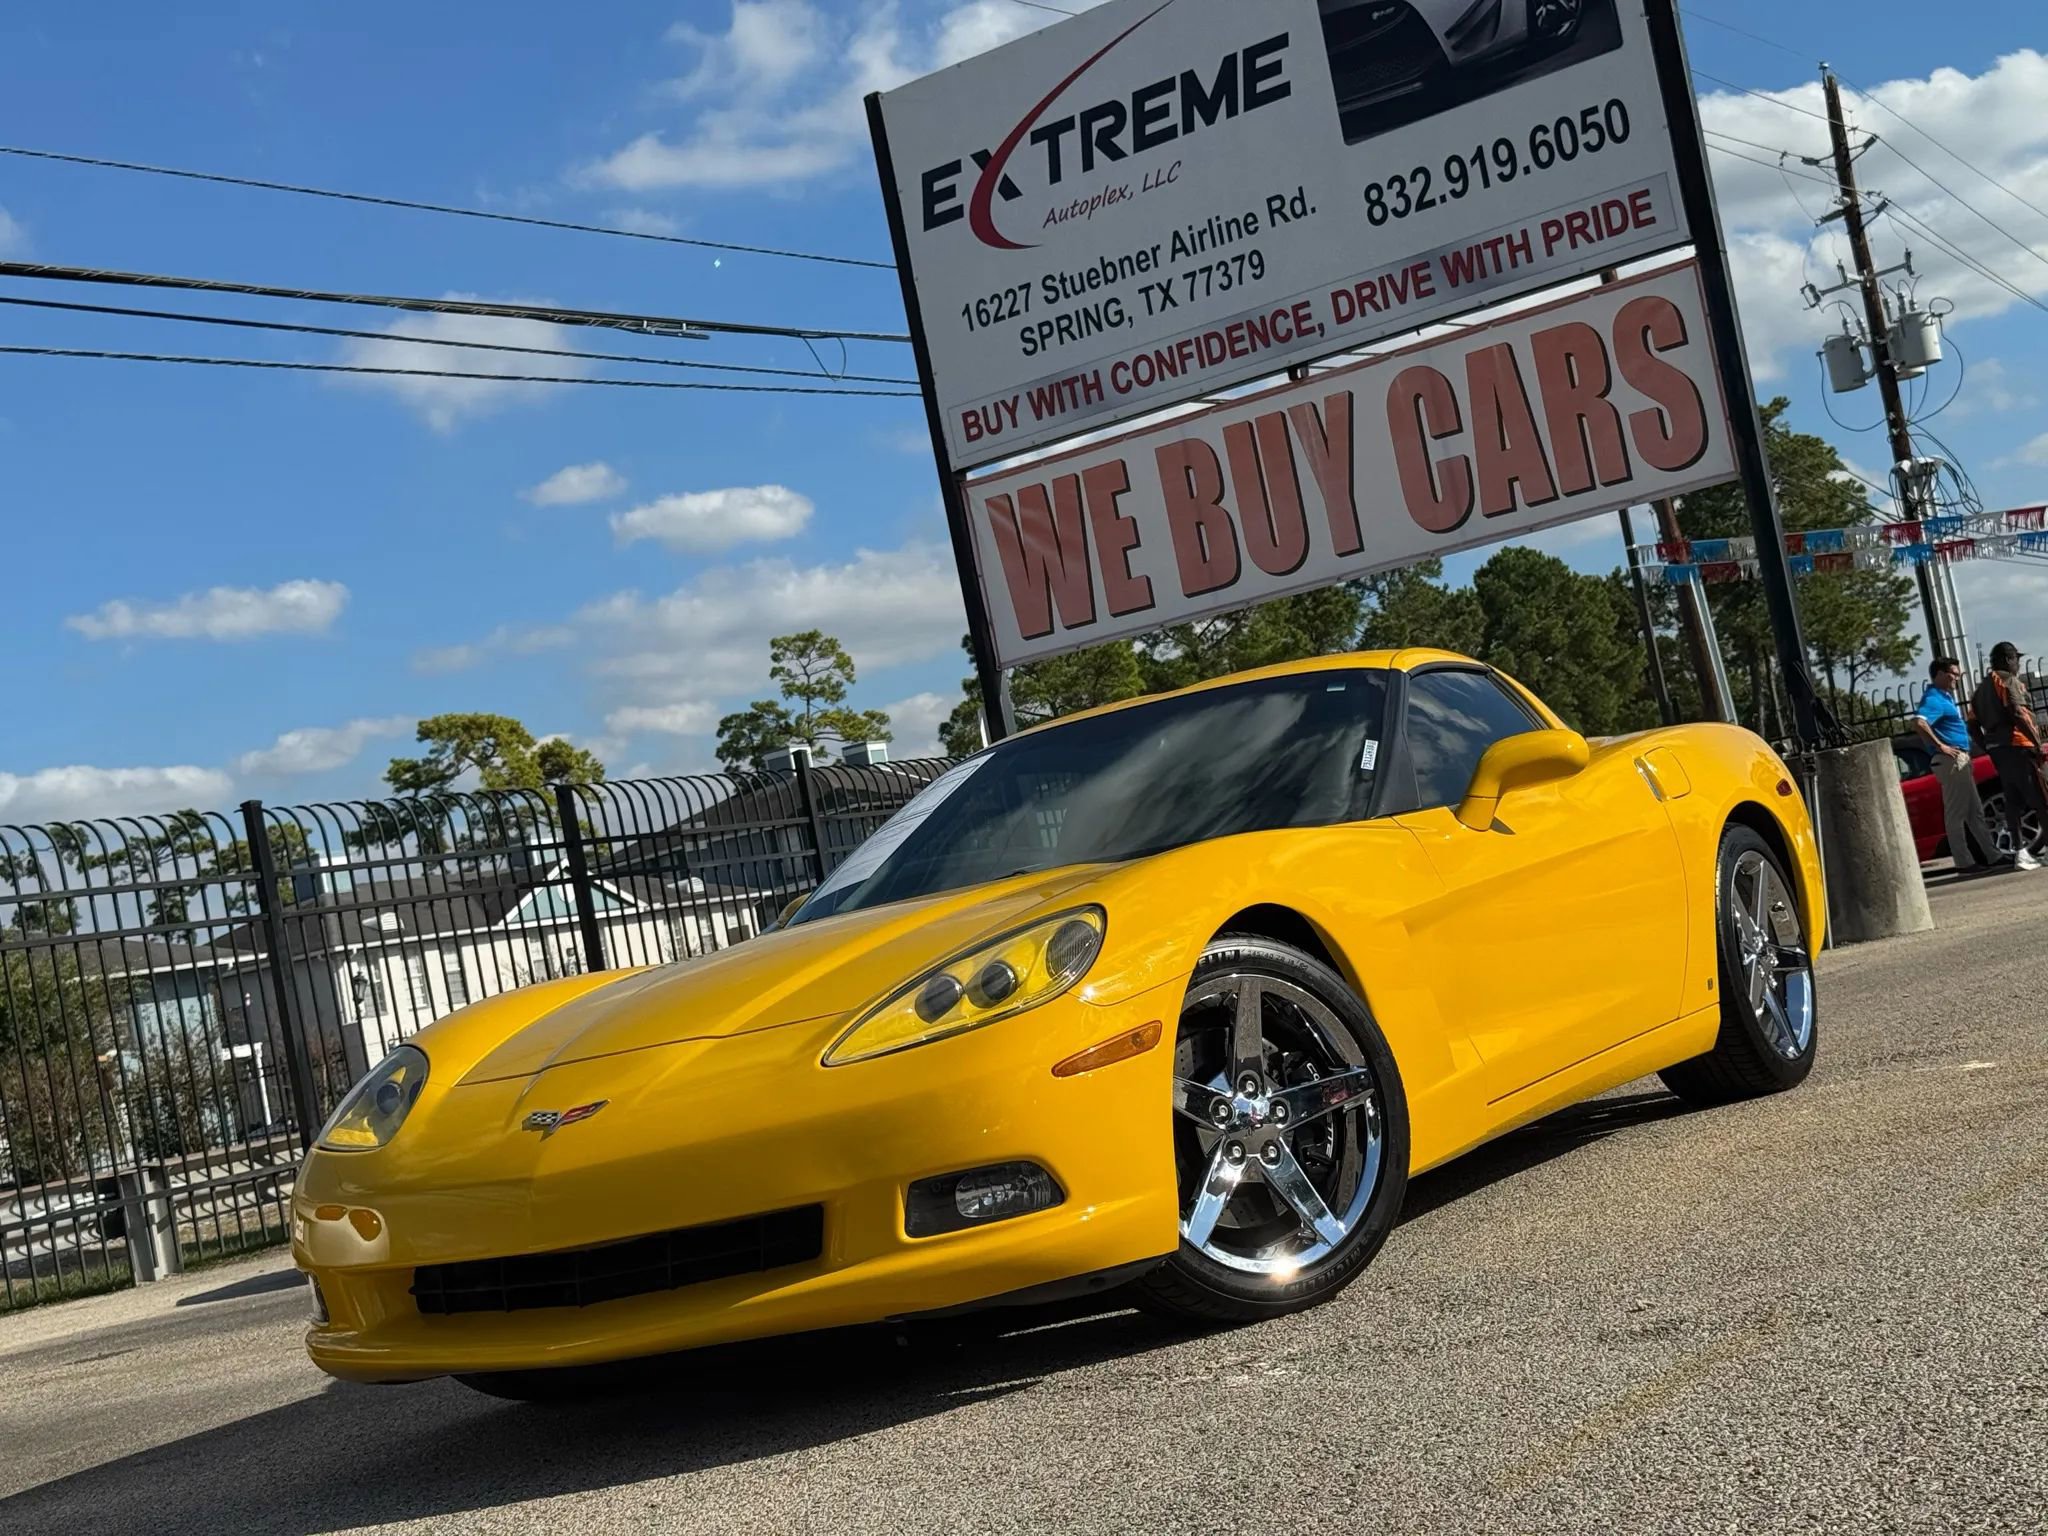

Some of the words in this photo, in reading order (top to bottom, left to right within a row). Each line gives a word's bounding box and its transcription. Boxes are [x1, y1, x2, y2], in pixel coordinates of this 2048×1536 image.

[921, 31, 1292, 233] EXTREME
[1042, 183, 1135, 231] Autoplex,
[1141, 160, 1182, 195] LLC
[1363, 98, 1631, 227] 832.919.6050
[961, 283, 1032, 332] 16227
[1041, 244, 1161, 305] Stuebner
[1169, 209, 1259, 263] Airline
[1265, 186, 1317, 228] Rd.
[961, 395, 1019, 443] BUY
[1026, 369, 1103, 421] WITH
[1110, 300, 1326, 396] CONFIDENCE,
[1330, 261, 1436, 326] DRIVE
[1439, 229, 1533, 288] WITH
[1540, 188, 1657, 257] PRIDE
[1020, 297, 1134, 357] SPRING,
[1138, 276, 1180, 317] TX
[1183, 249, 1266, 302] 77379
[985, 458, 1156, 641] WE
[1153, 390, 1365, 599] BUY
[1386, 295, 1709, 534] CARS
